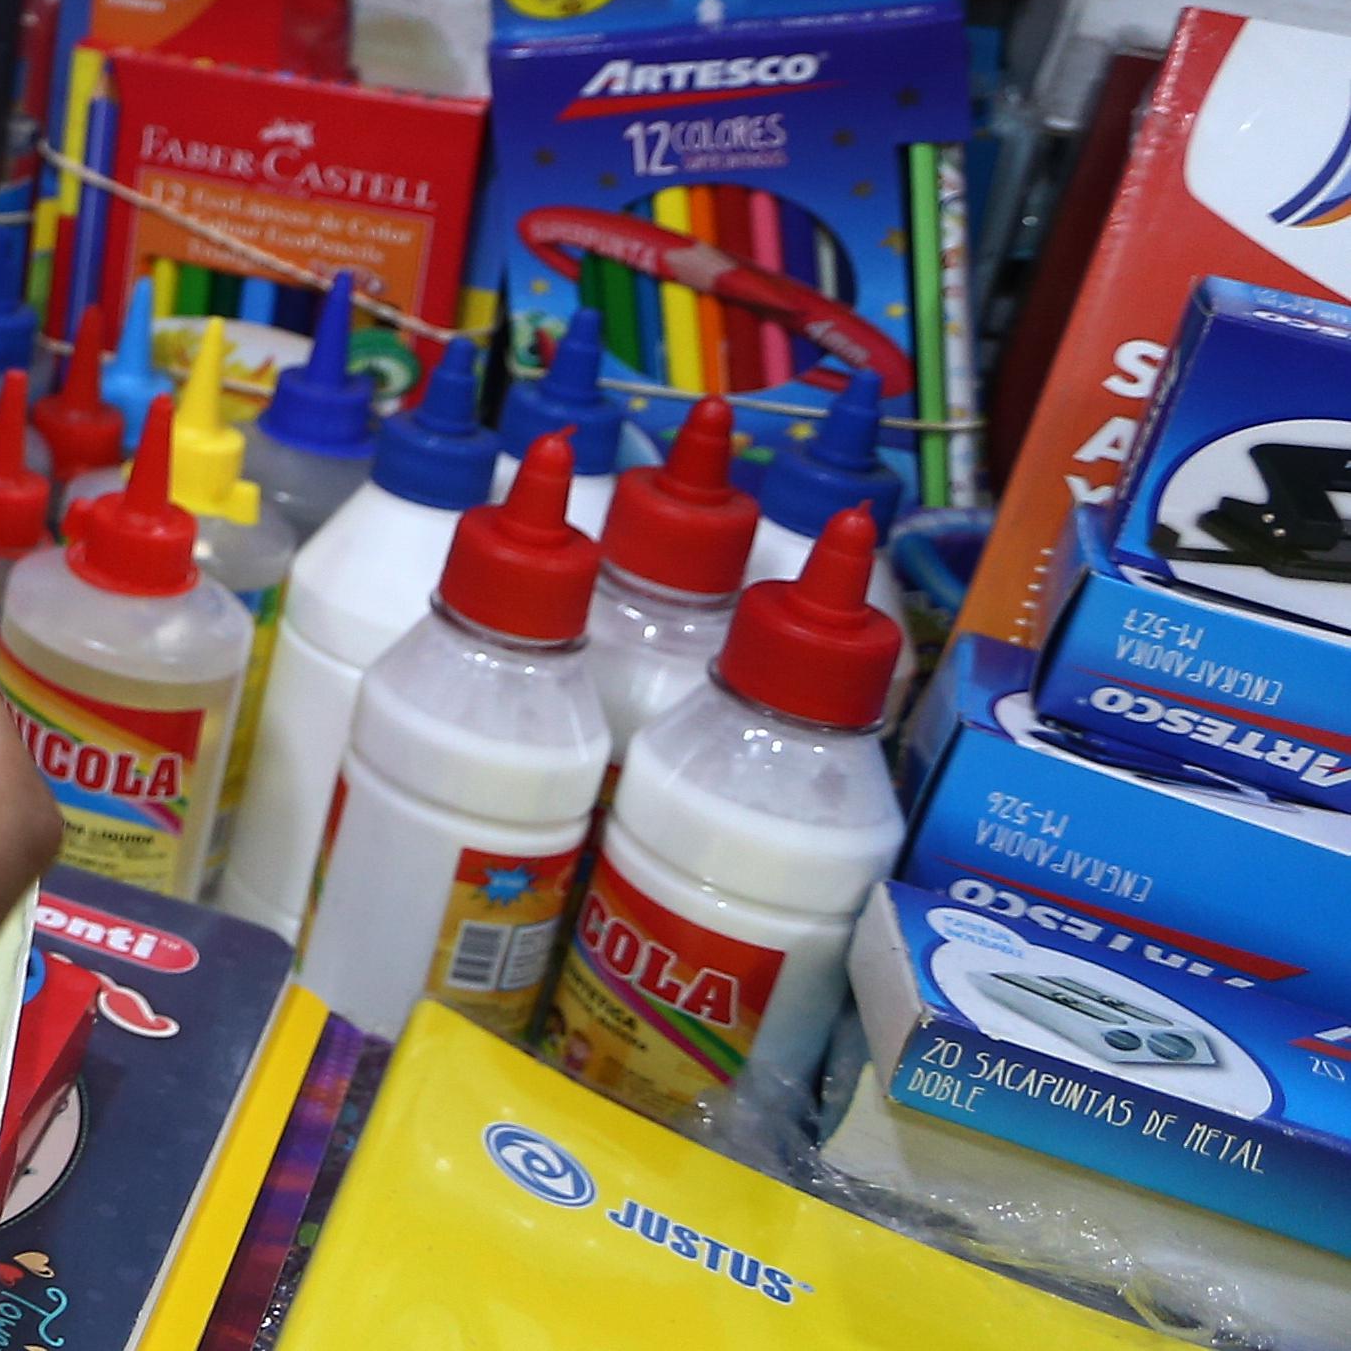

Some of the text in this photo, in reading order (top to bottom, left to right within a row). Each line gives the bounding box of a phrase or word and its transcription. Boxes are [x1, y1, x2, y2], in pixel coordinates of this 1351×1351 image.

[580, 52, 820, 98] ARTESCO
[140, 124, 431, 210] FABER CASTELL
[622, 120, 678, 176] 12
[670, 113, 789, 155] COLORES
[1123, 608, 1206, 649] M-527
[1090, 685, 1351, 787] ARTESCO
[986, 790, 1070, 839] M-526
[579, 894, 738, 1029] COLA
[908, 1068, 986, 1113] DOBLE
[921, 1037, 1265, 1174] 20 SACAPUNTAS DE METAL
[605, 1199, 795, 1305] JUSTUS
